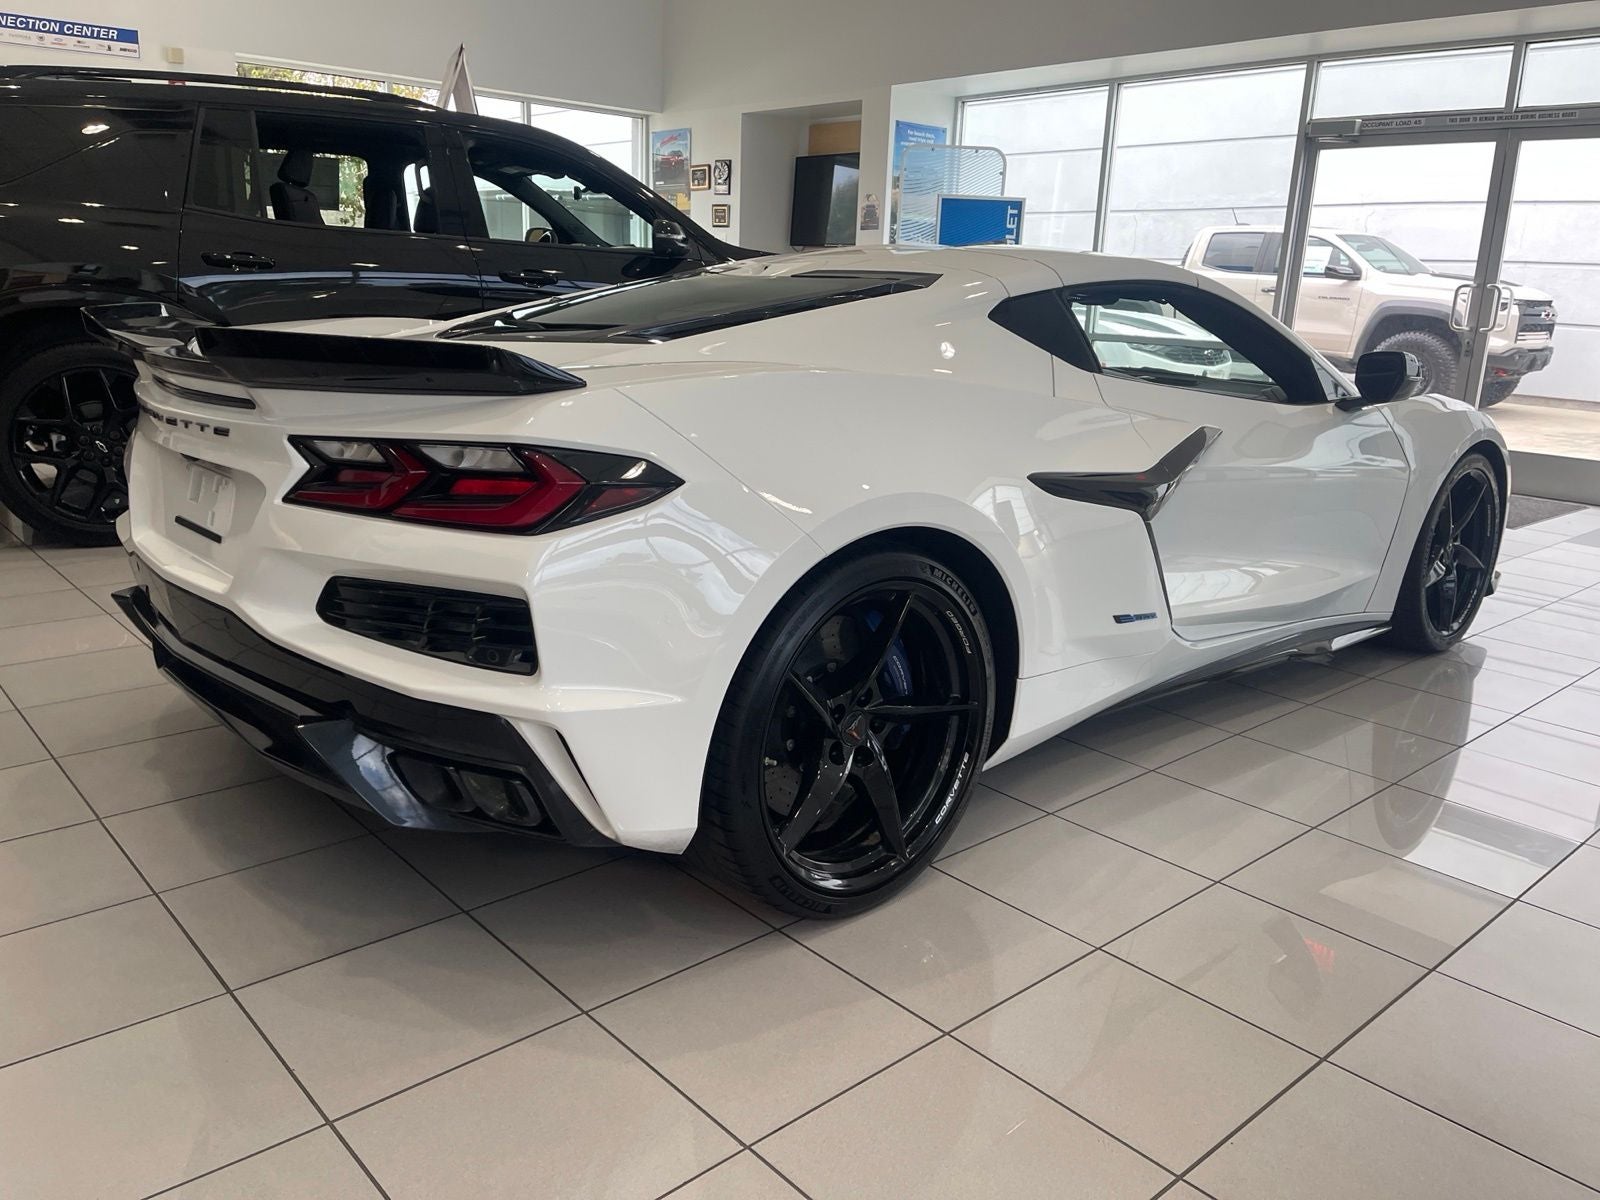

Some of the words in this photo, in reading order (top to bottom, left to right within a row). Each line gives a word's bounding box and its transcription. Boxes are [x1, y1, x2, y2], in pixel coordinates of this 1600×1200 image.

[63, 23, 118, 40] CENTER
[932, 566, 977, 614] MICHELIN
[945, 609, 972, 655] FORGED
[934, 751, 970, 825] CORVETTE
